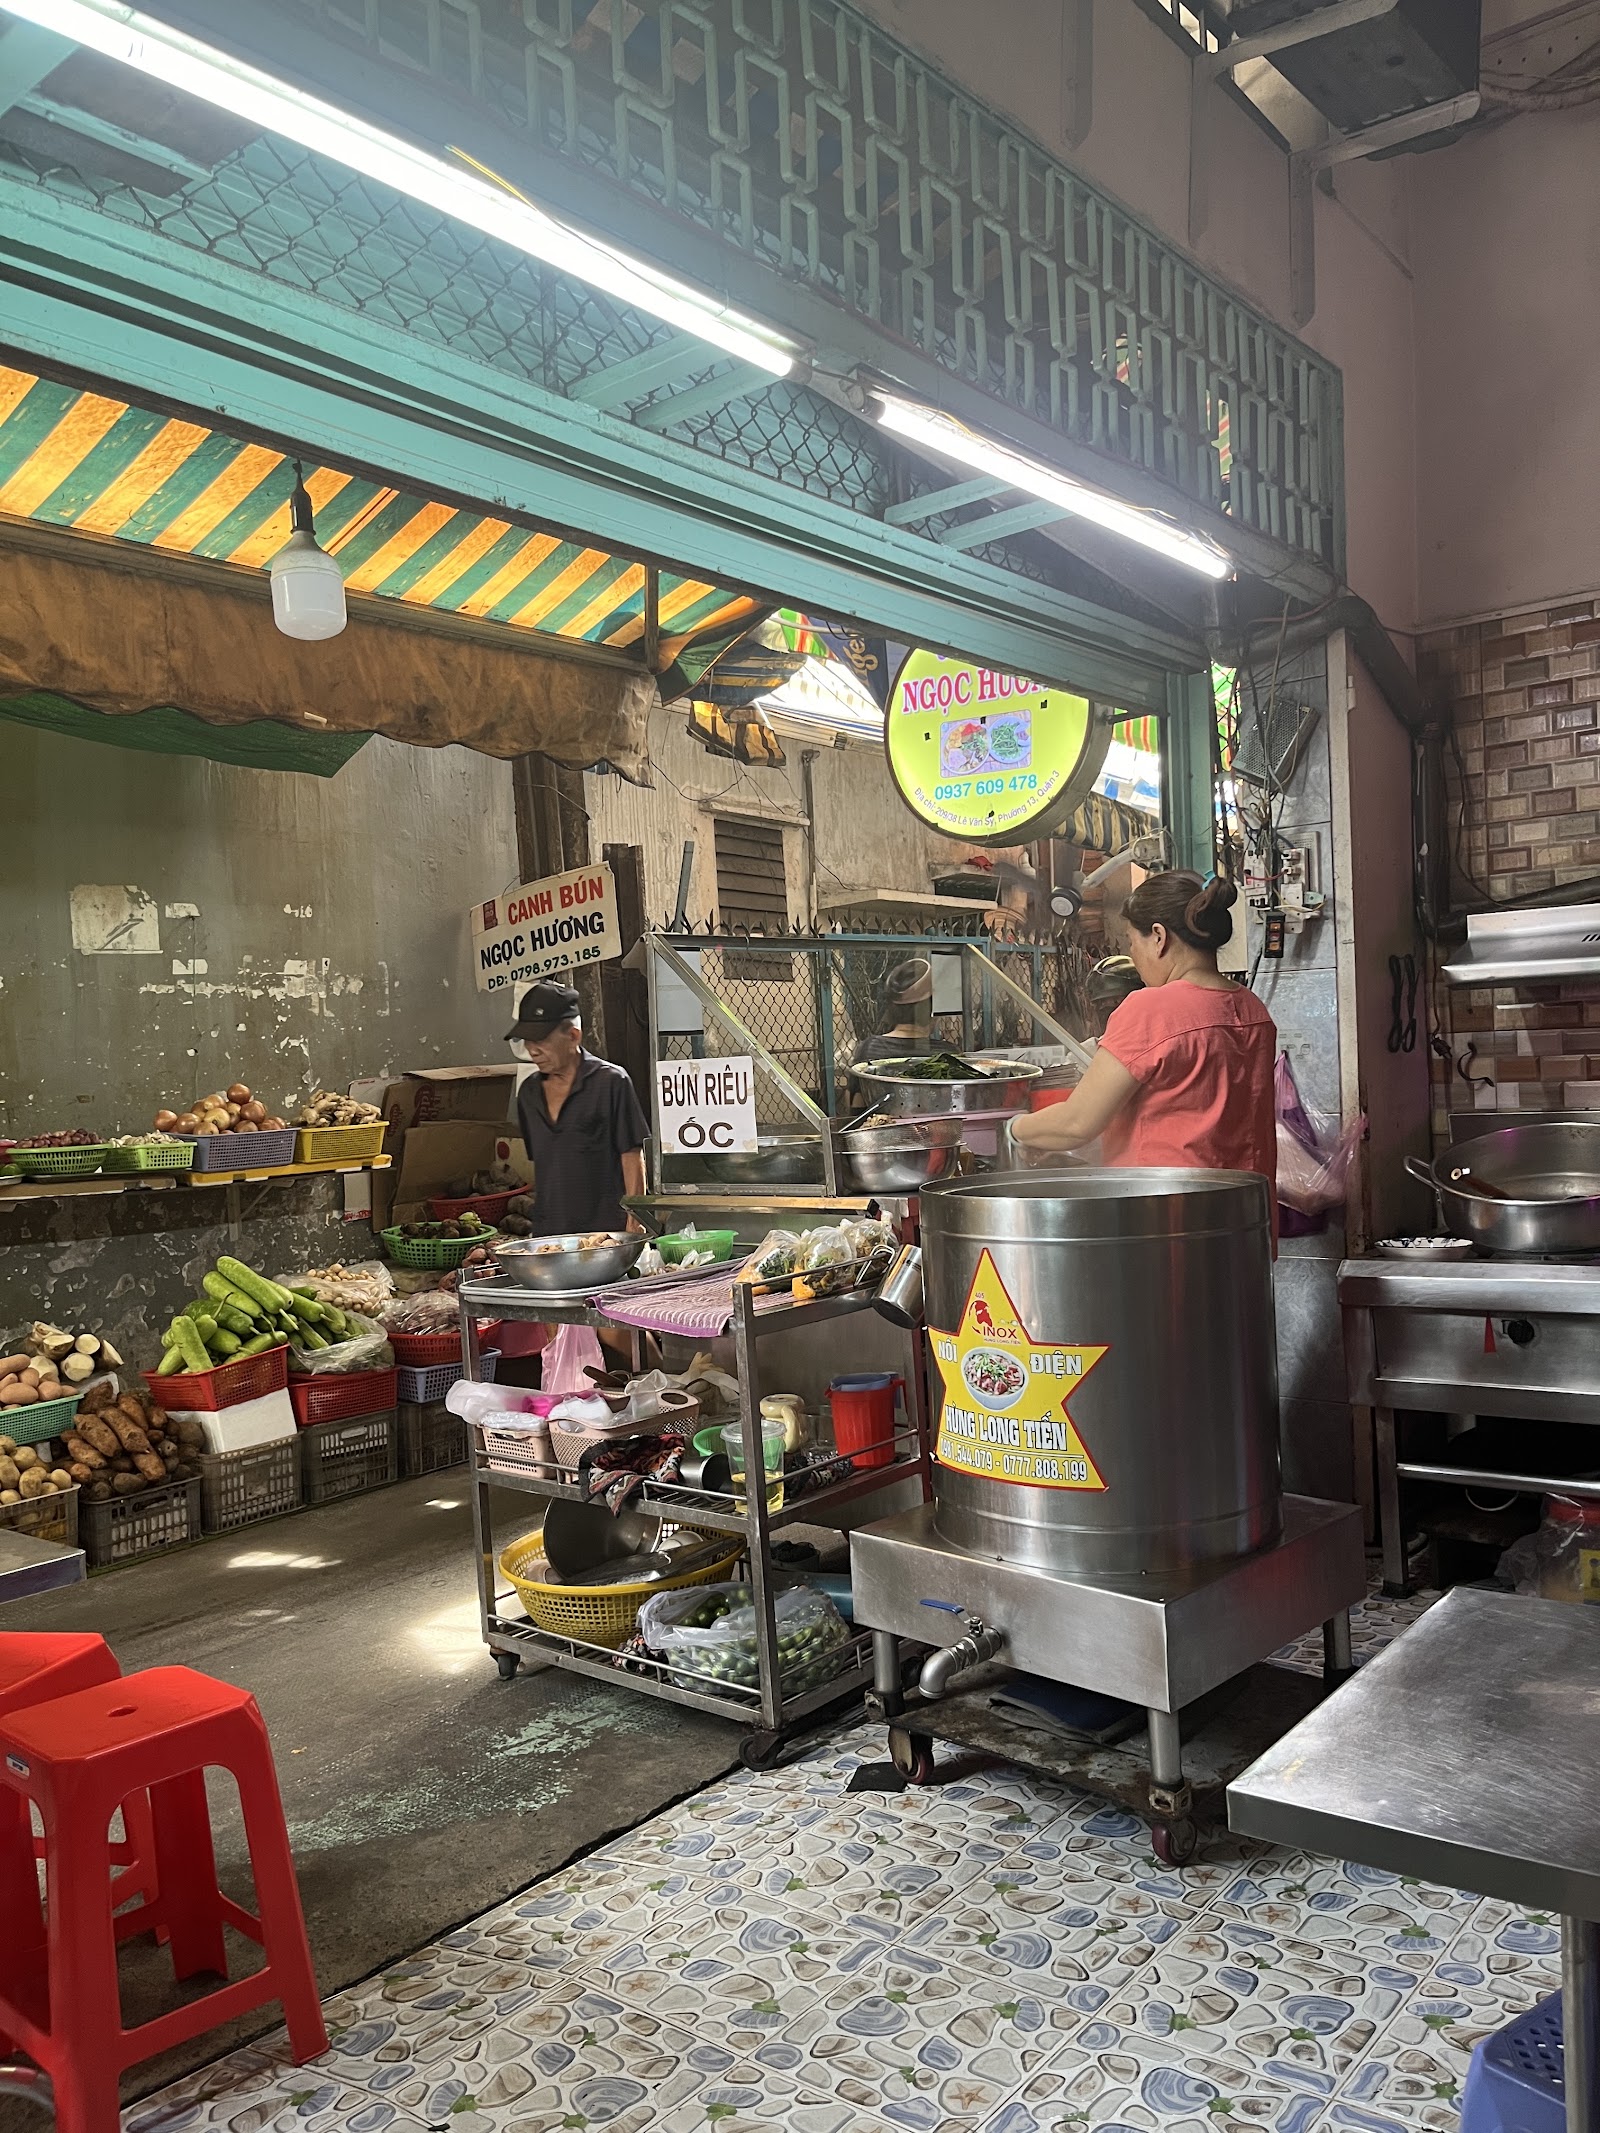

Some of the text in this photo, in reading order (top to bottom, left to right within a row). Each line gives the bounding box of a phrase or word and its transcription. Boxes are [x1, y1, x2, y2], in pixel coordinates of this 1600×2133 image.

[902, 672, 971, 714] NGỌC
[935, 774, 1038, 800] 0937 609 478
[935, 806, 958, 824] 209/38
[958, 816, 968, 825] Lê
[1027, 796, 1039, 808] 13,
[1052, 769, 1060, 778] 3
[507, 889, 554, 926] CANH
[559, 874, 604, 909] BÚN
[480, 935, 526, 970] NGỌC
[530, 911, 605, 952] HƯƠNG
[487, 945, 601, 990] DĐ: 0798.973.185
[661, 1064, 748, 1107] BÚN RIÊU
[678, 1116, 735, 1149] ỐC
[983, 1326, 1018, 1340] INOX
[1029, 1350, 1083, 1380] ĐIỆN
[944, 1400, 1068, 1452] HÙNG LONG TIẾN
[940, 1437, 993, 1472] 0981.544.079
[1002, 1454, 1088, 1482] 0777.808.199
